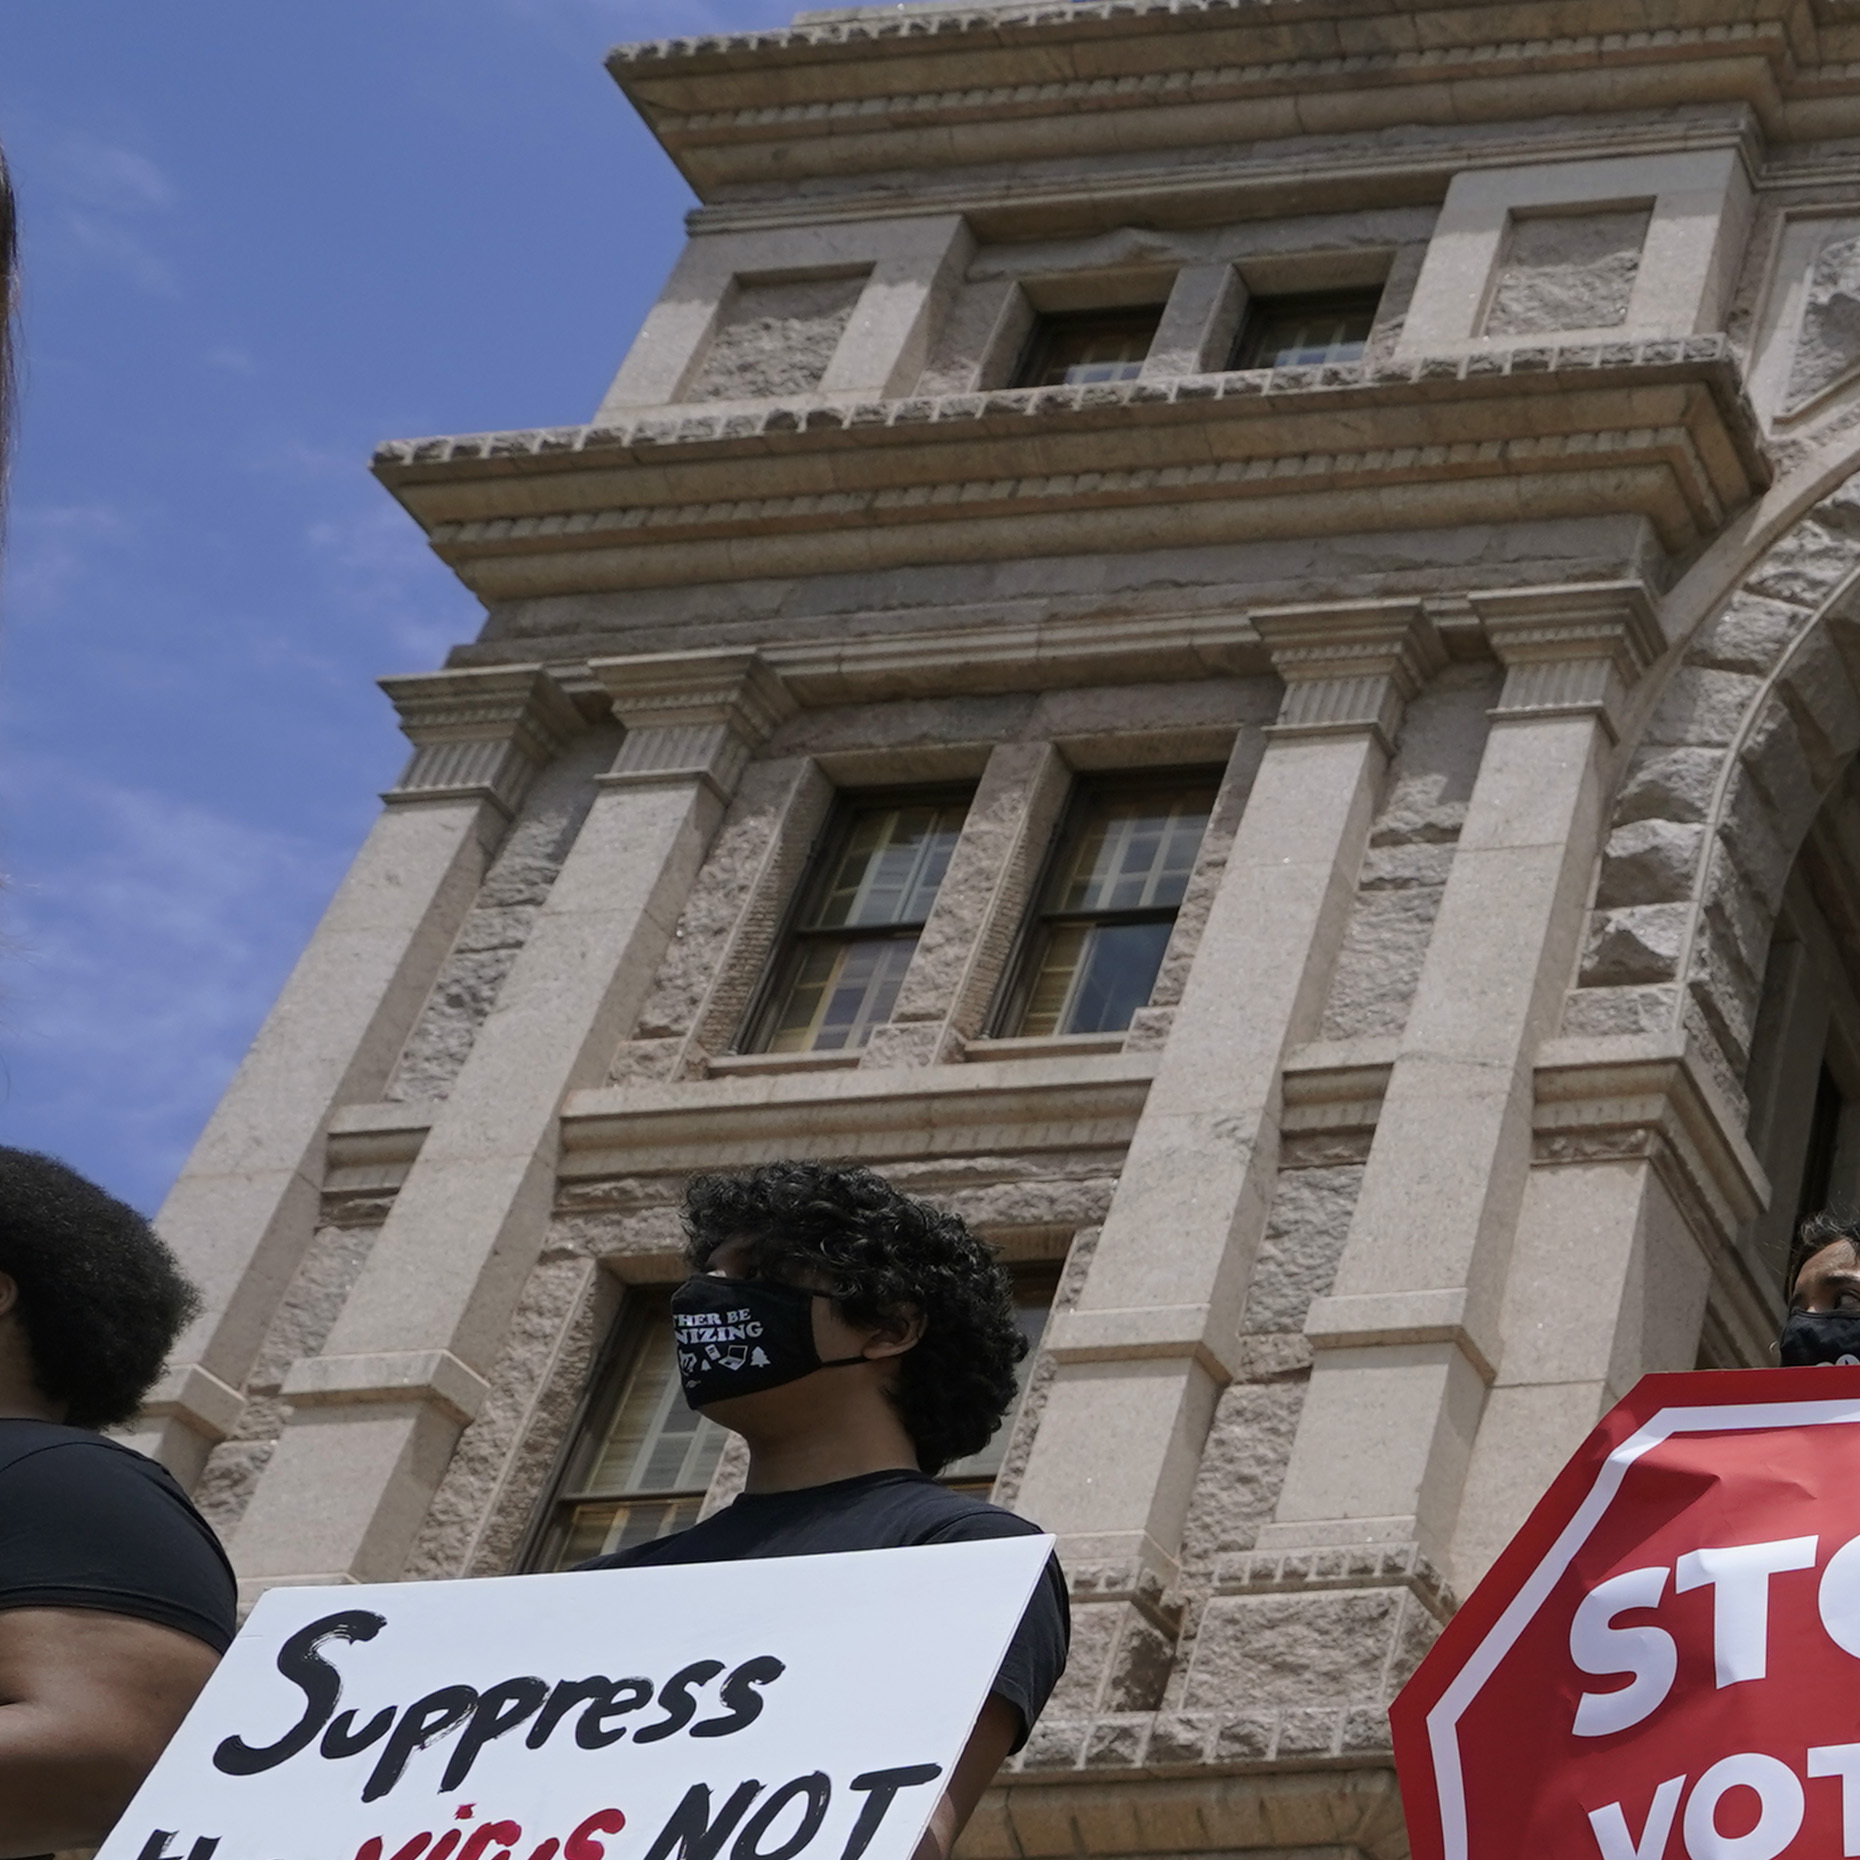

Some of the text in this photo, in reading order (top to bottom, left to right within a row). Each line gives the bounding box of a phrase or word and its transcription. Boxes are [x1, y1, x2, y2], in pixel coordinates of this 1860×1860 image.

[673, 1308, 752, 1327] HER BE
[212, 1608, 786, 1803] Suppress
